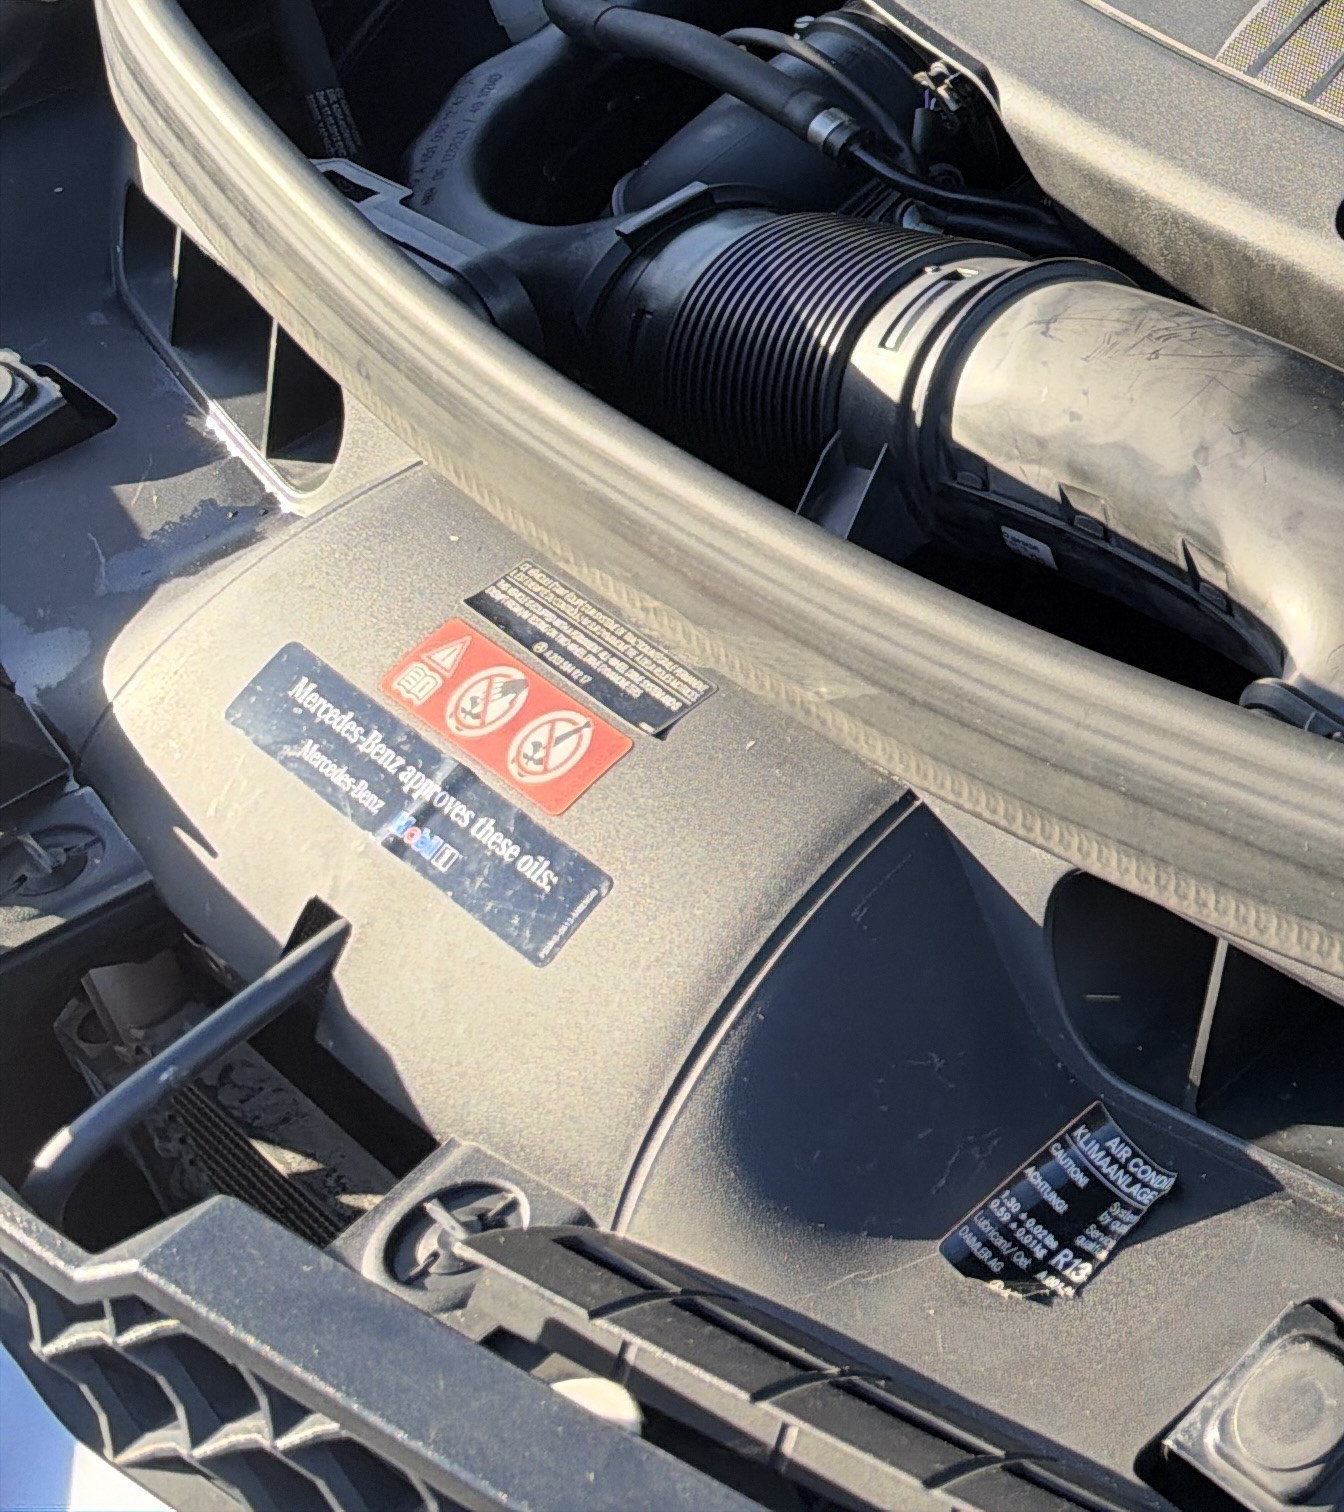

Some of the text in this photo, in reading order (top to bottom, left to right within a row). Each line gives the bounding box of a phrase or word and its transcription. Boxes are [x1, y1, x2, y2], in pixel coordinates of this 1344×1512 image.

[288, 676, 560, 894] Mercedes-Benz approves these oils:
[299, 738, 386, 816] Mercedes-Benz
[1050, 1142, 1090, 1189] CAUTION!
[1072, 1124, 1158, 1205] KLIMAANLAGE
[1105, 1136, 1133, 1164] AIR
[1023, 1165, 1069, 1215] ACHTUNG!
